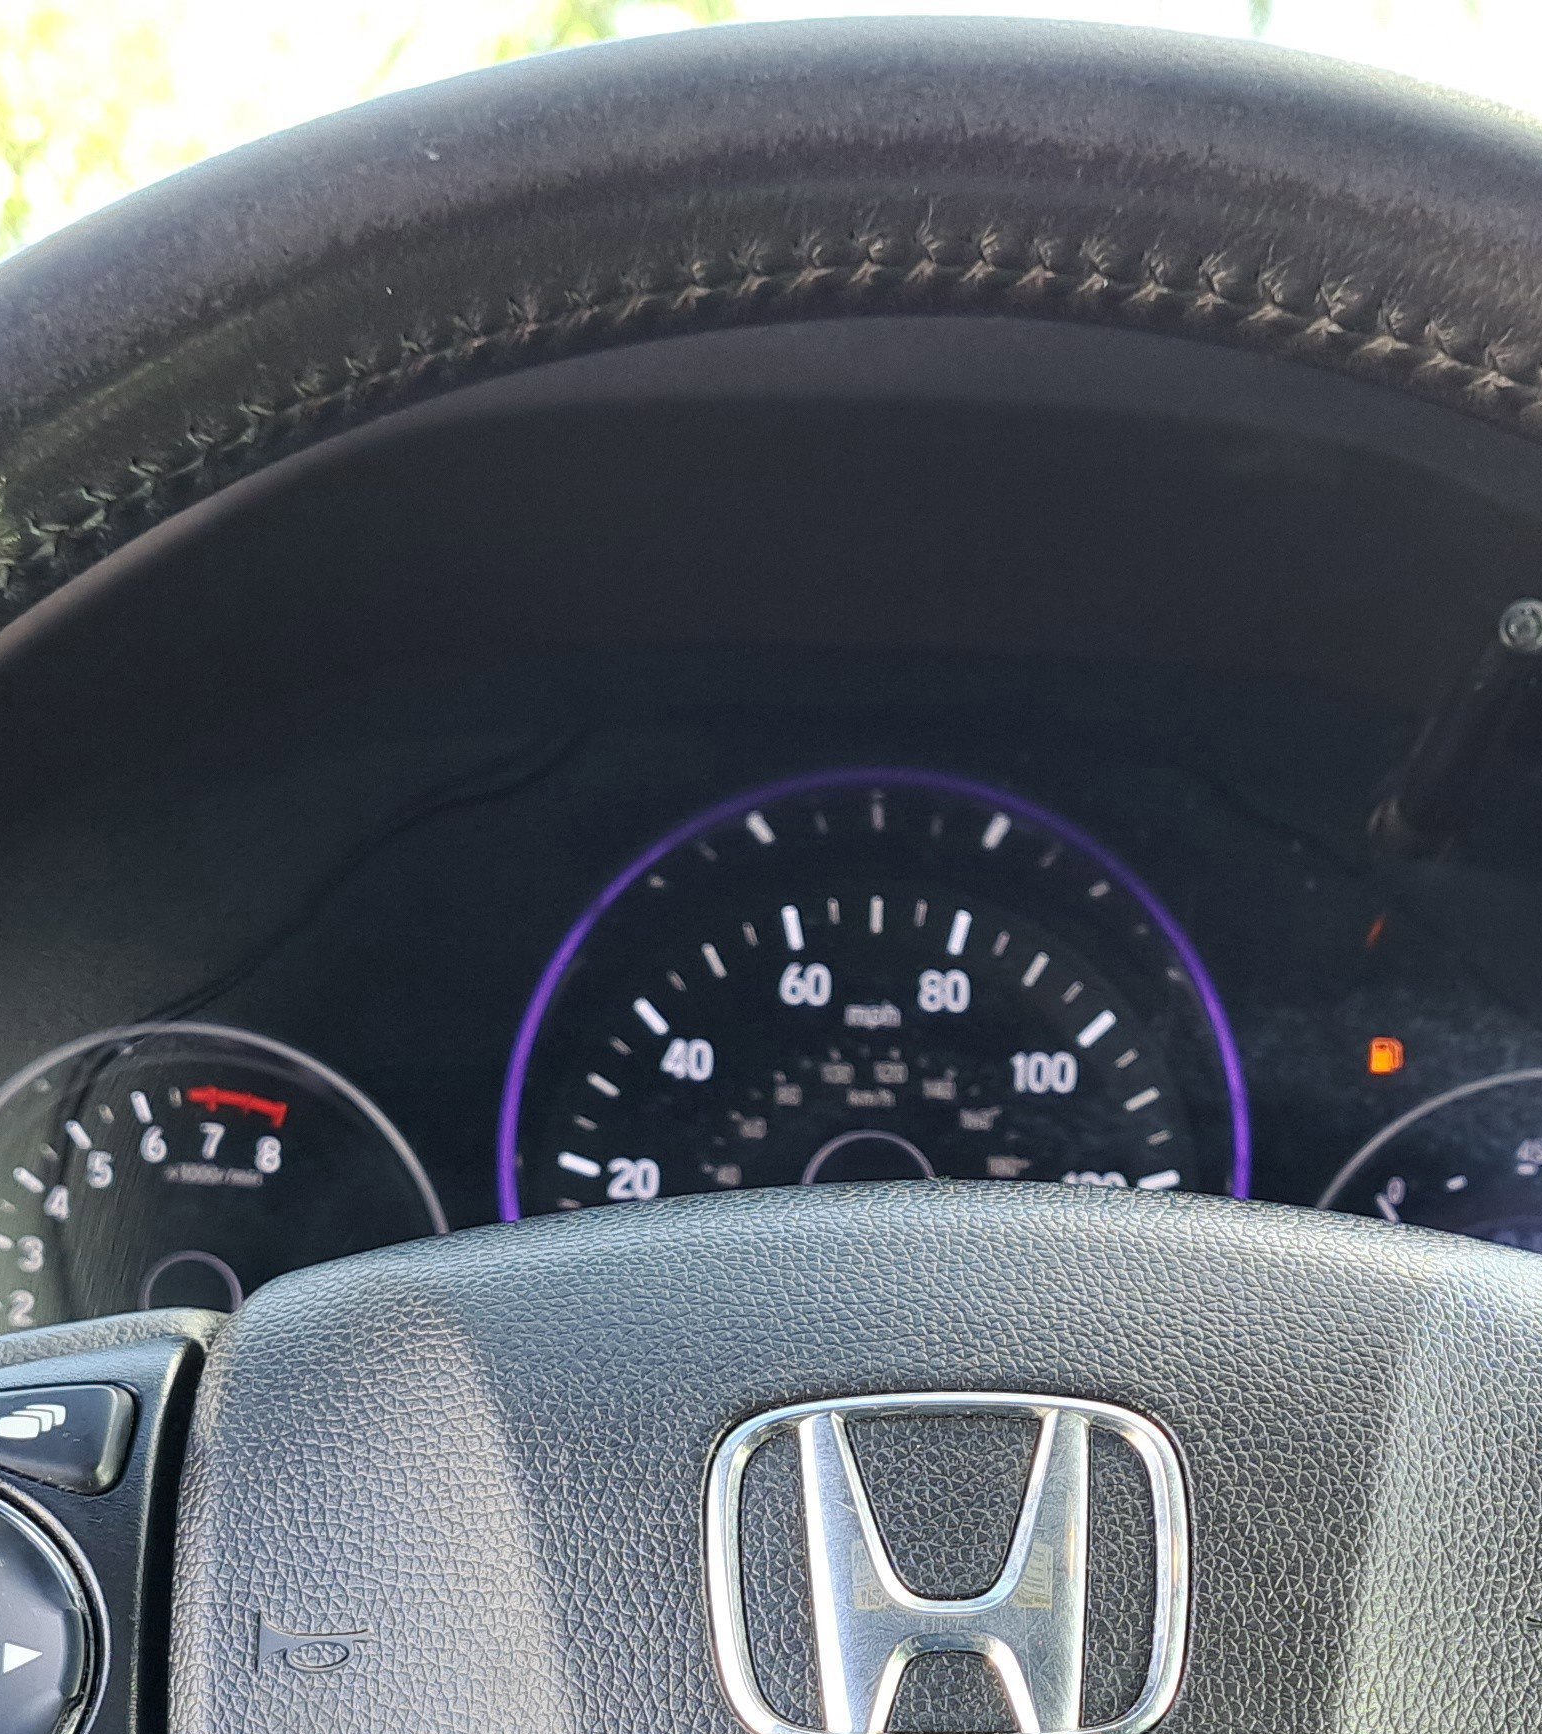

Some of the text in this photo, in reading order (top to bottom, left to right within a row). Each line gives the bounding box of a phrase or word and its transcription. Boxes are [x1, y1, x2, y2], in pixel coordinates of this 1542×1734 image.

[779, 962, 833, 1007] 60
[918, 969, 970, 1013] 80
[660, 1038, 714, 1082] 40
[1010, 1051, 1078, 1094] 100
[140, 1125, 167, 1163] 6
[199, 1122, 226, 1160] 7
[254, 1135, 282, 1174] 8
[86, 1150, 115, 1189] 5
[607, 1157, 660, 1200] 20
[44, 1184, 71, 1221] 4
[15, 1236, 45, 1273] 3
[8, 1290, 35, 1328] 2
